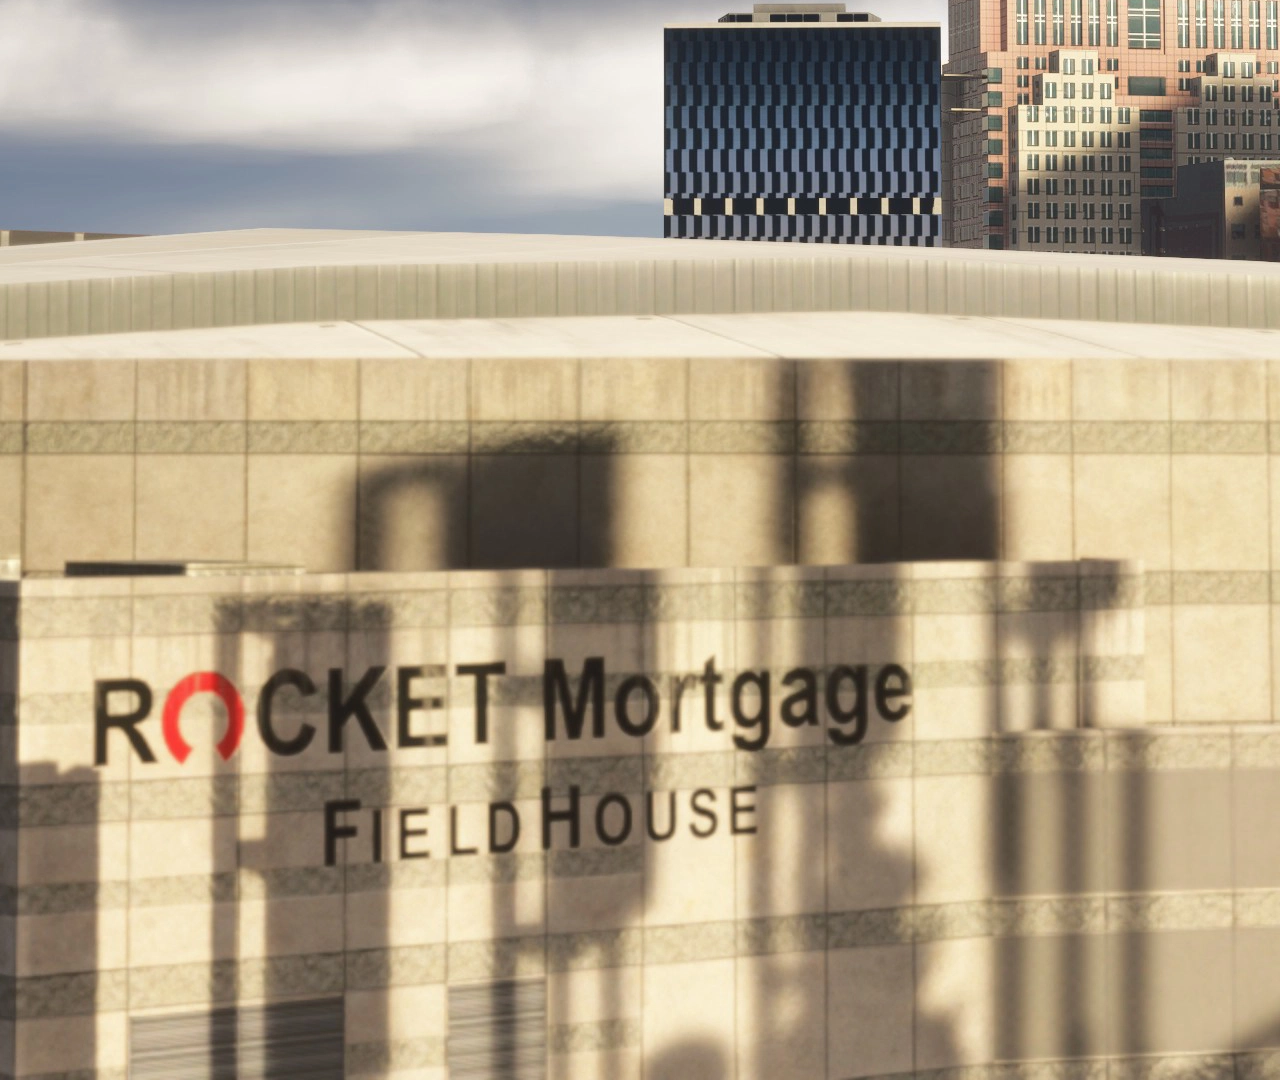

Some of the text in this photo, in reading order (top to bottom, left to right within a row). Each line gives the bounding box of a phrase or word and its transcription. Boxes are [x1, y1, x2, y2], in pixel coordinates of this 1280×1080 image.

[93, 656, 914, 768] ROCKET Mortgage
[323, 784, 760, 867] FIELDHOUSE
